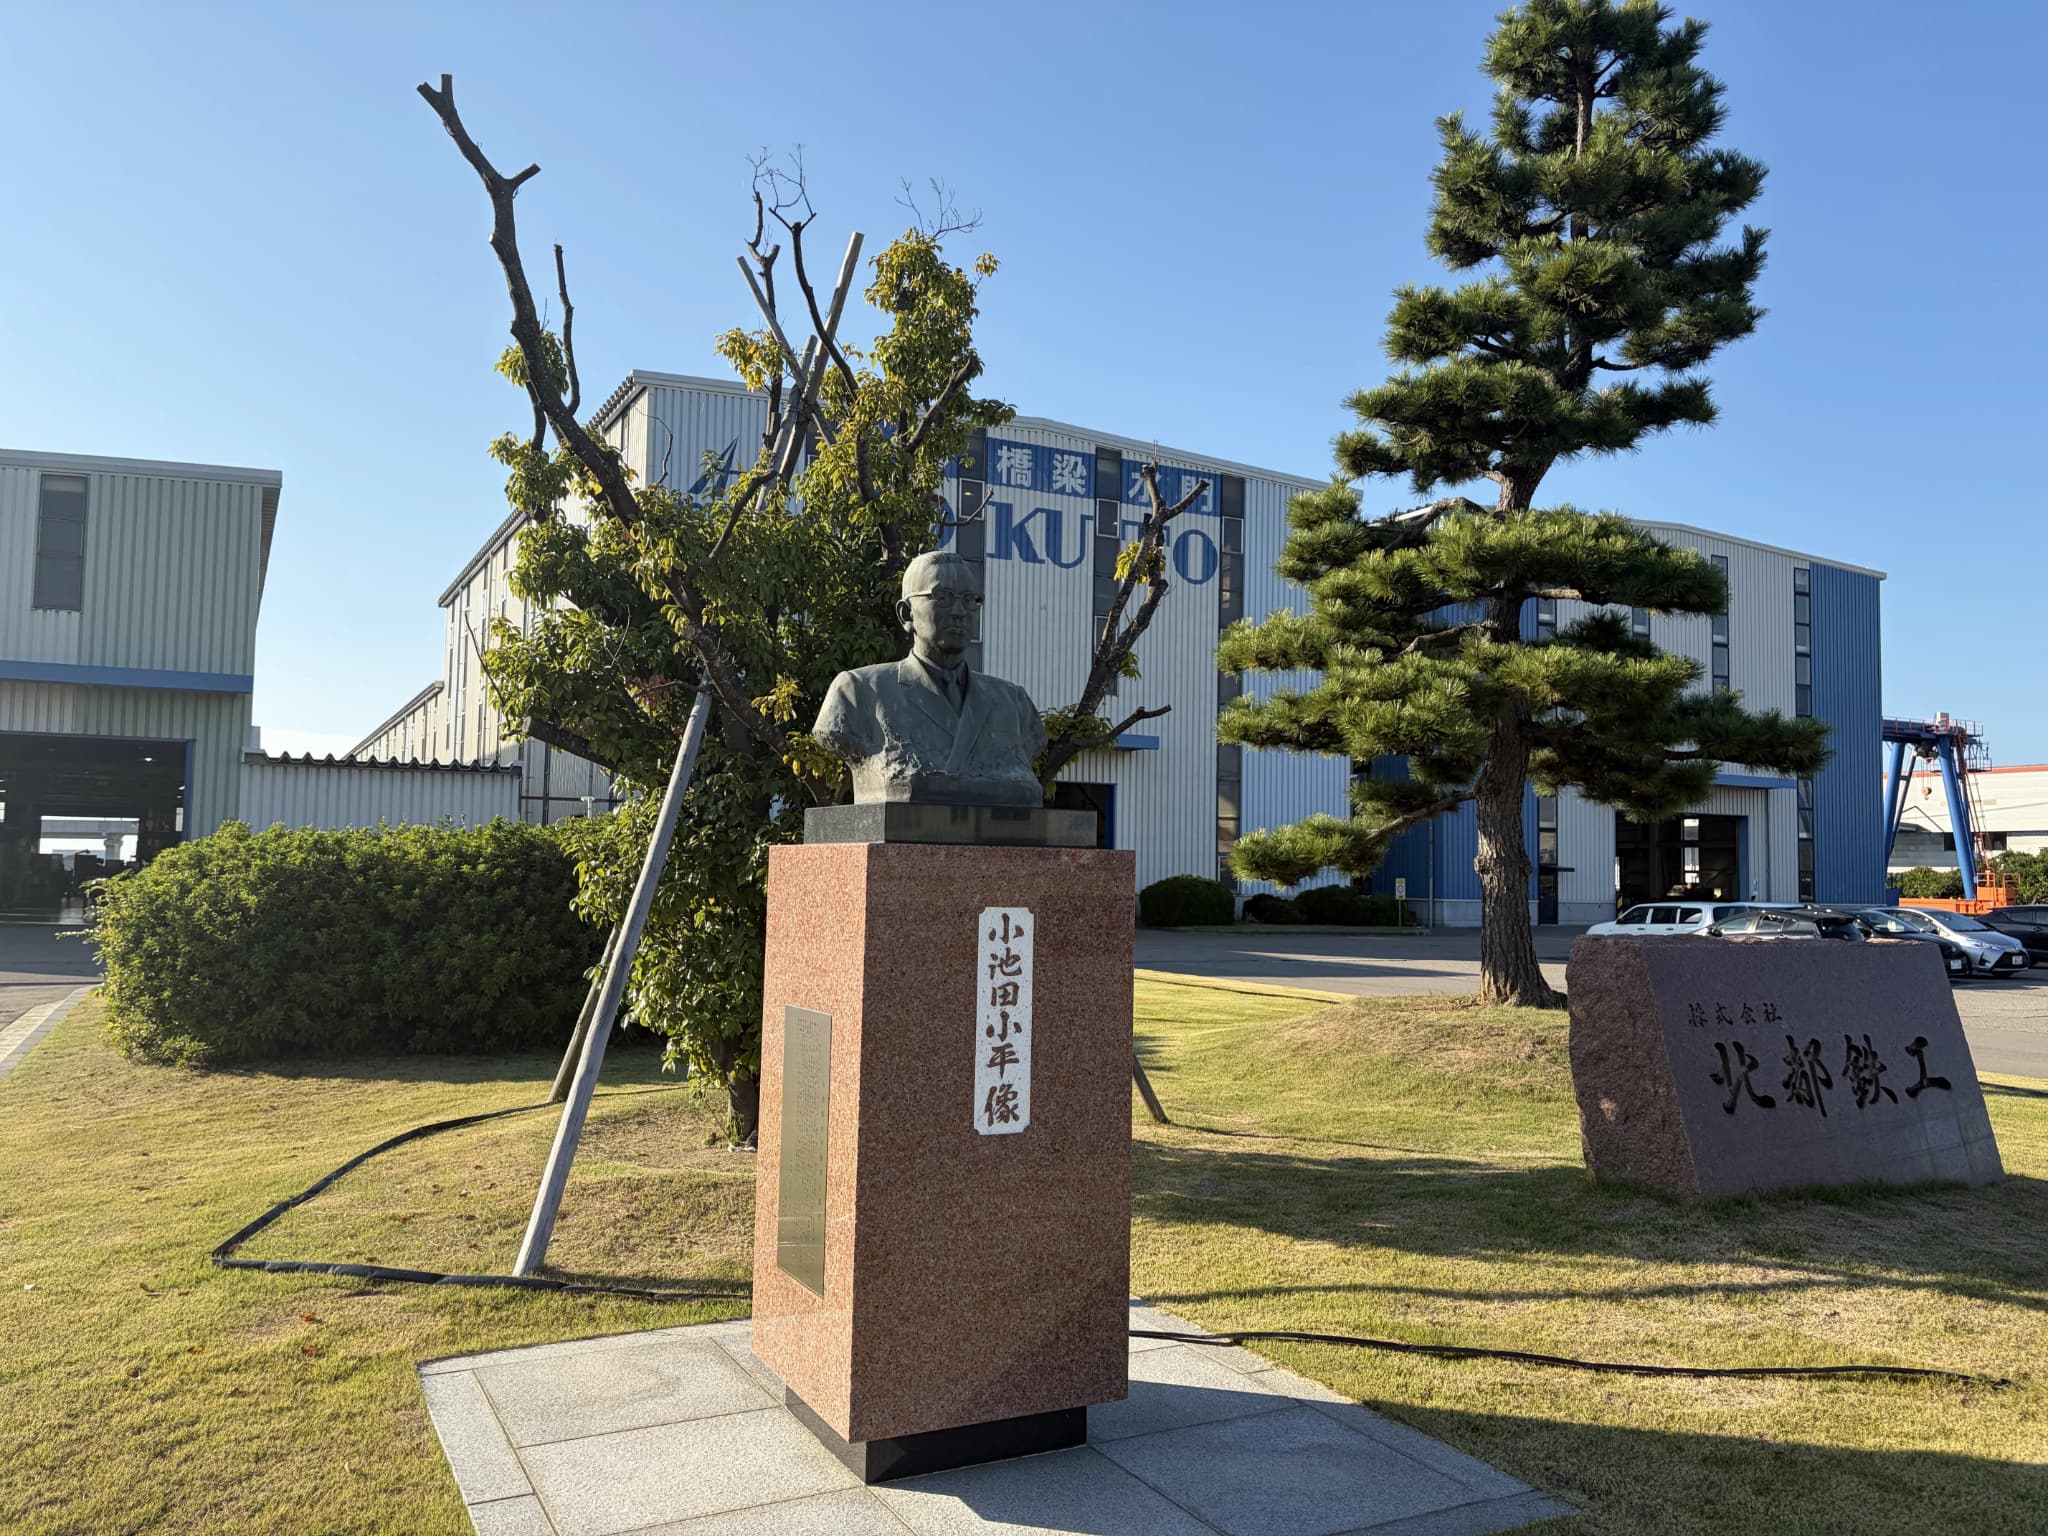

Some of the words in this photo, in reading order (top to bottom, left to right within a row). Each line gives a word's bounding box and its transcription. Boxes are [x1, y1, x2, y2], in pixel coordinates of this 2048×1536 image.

[997, 445, 1087, 496] 橋梁
[1688, 1001, 1783, 1028] 株式会社
